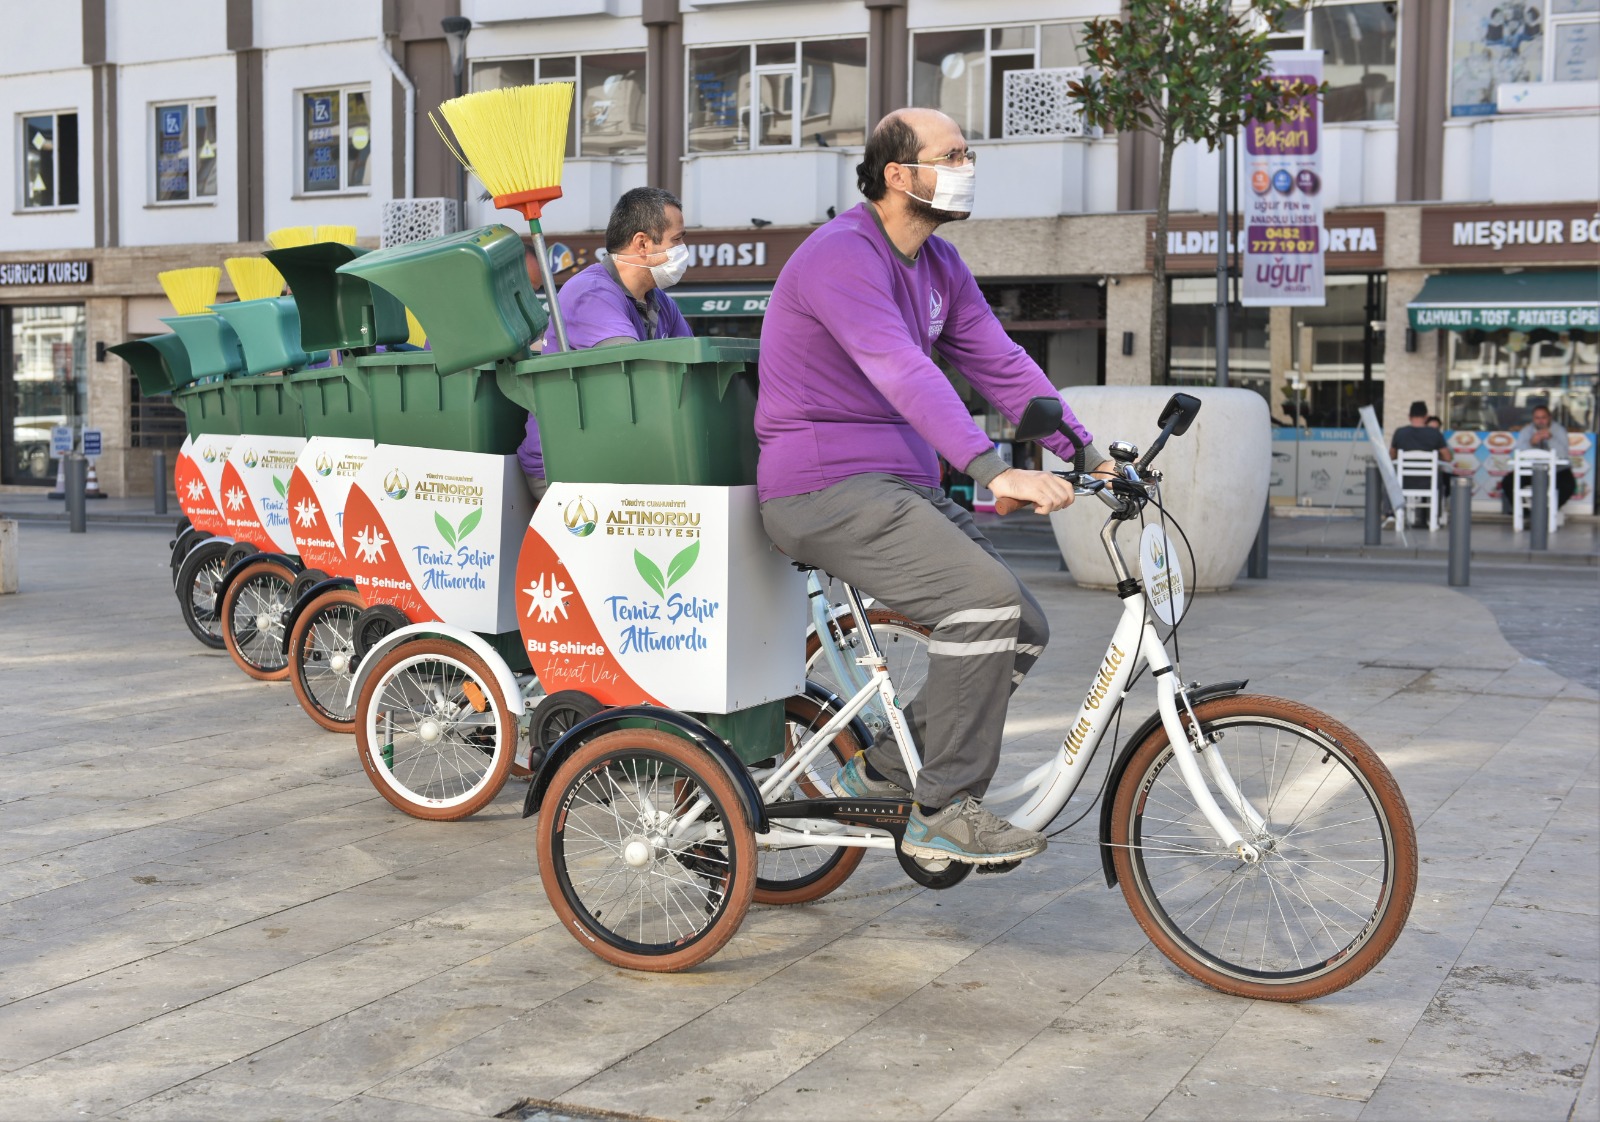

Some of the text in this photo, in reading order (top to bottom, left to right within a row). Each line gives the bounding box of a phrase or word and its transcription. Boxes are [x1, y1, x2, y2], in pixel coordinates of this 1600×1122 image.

[1283, 202, 1299, 210] FEN
[1251, 215, 1288, 223] ANADOLU
[1265, 228, 1300, 239] 0452
[1453, 220, 1564, 250] MEŞHUR
[1252, 241, 1277, 252] 777
[0, 261, 88, 285] SÜRÜCÜ KURSU
[1256, 257, 1312, 288] uğur
[701, 299, 731, 311] SU
[1417, 309, 1472, 325] KAHVALTI
[1480, 310, 1510, 325] TOST
[1517, 310, 1567, 325] PATATES
[415, 481, 483, 496] ALTINORDU
[415, 493, 483, 506] BELEDİYESİ
[227, 518, 260, 528] Bu Şehirde
[605, 510, 701, 526] ALTINORDU
[606, 526, 701, 538] BELEDİYESİ
[295, 536, 335, 548] Bu Şehirde
[412, 545, 495, 569] Temiz Şehir
[355, 575, 412, 590] Bu Şehirde
[604, 592, 719, 624] Temiz Şehir
[619, 625, 707, 654] Altınordu
[527, 639, 605, 656] Bu Şehirde
[543, 657, 620, 685] Hayat Var
[1084, 642, 1125, 710] Bisiklet
[838, 806, 894, 814] CARAVAN
